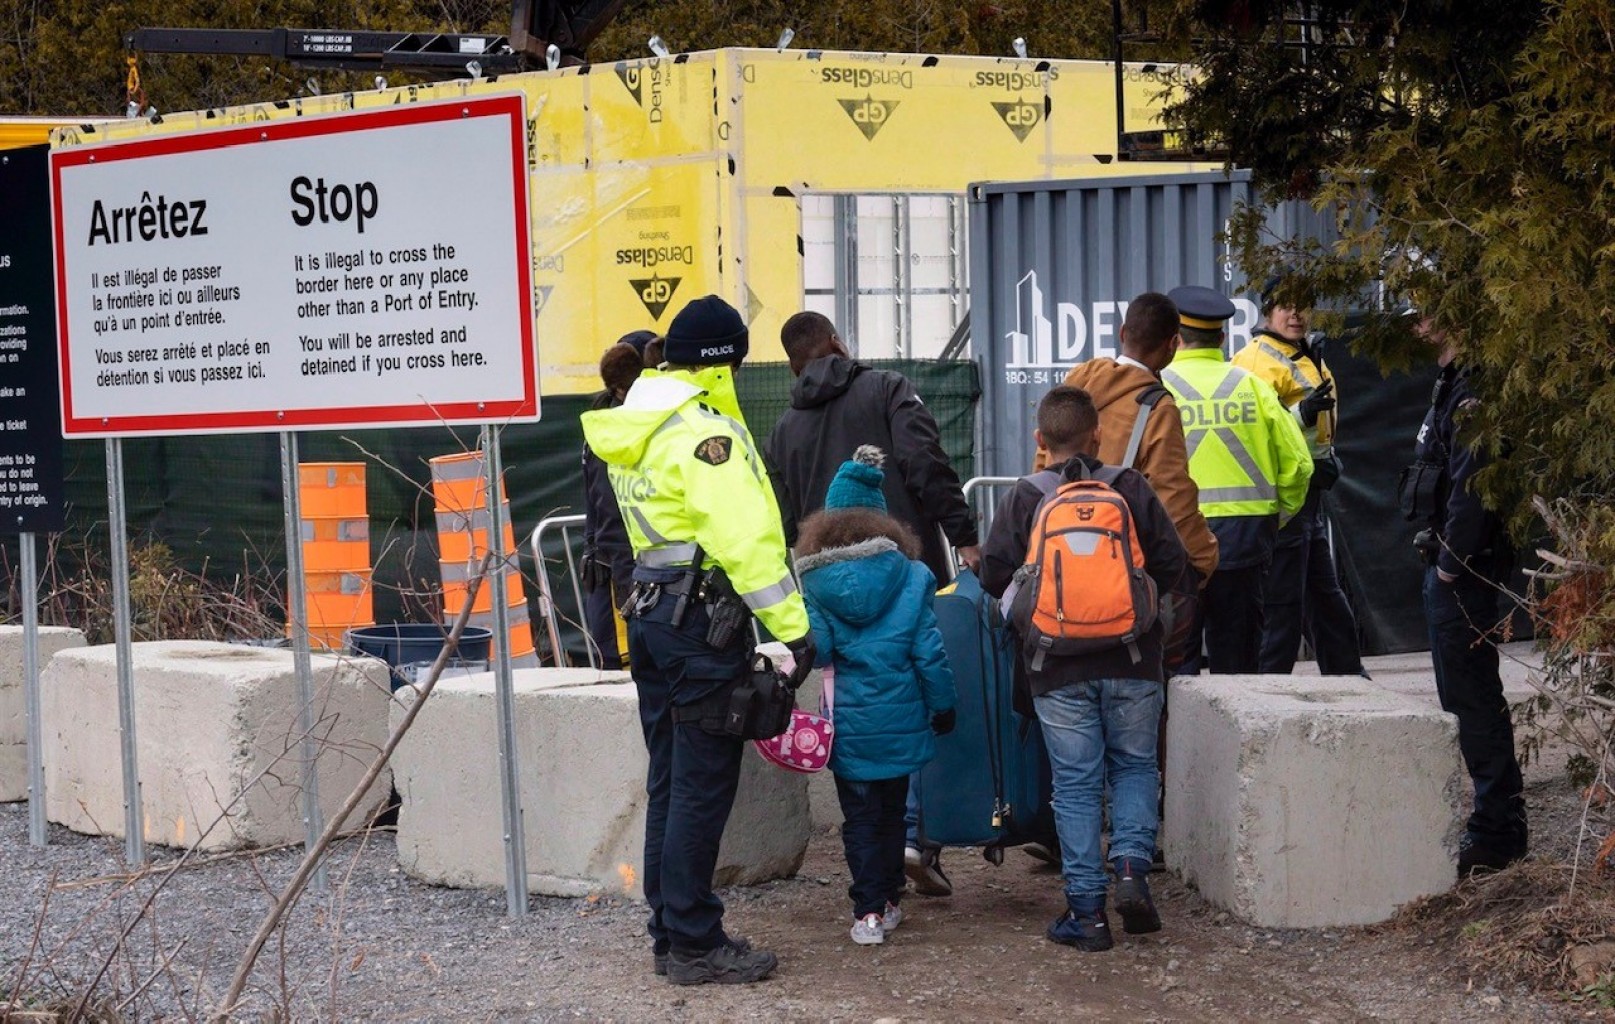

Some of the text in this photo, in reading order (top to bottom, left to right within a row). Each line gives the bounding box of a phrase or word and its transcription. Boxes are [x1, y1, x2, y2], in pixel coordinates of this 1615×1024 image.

[822, 67, 913, 89] DensGlass
[853, 102, 887, 123] GP
[1006, 105, 1038, 126] GP
[290, 176, 378, 234] Stop
[88, 191, 208, 246] Arrêtez
[295, 243, 455, 271] It is illegal to cross the
[616, 246, 693, 268] DensGlass
[92, 266, 221, 288] Il est illégal de passer
[296, 267, 468, 294] border here or any place
[93, 285, 240, 311] la frontière ici ou ailleurs
[642, 280, 671, 304] GP
[298, 290, 478, 318] other than a Port of Entry.
[94, 308, 225, 336] qu'à un point d'entrée.
[299, 326, 466, 351] You will be arrested and
[8, 354, 19, 363] on
[96, 339, 270, 364] Vous serez arrêté et placé en
[700, 344, 735, 358] POLICE
[97, 362, 265, 386] détention si vous passez ici.
[301, 350, 486, 376] detained if you cross here.
[1034, 371, 1049, 384] 54
[15, 387, 25, 397] an
[1179, 401, 1257, 427] OLICE
[6, 420, 27, 431] ticket
[15, 455, 24, 465] to
[25, 454, 36, 464] be
[8, 468, 19, 479] do
[20, 468, 34, 478] not
[9, 482, 18, 492] to
[19, 481, 39, 492] leave
[14, 494, 22, 505] of
[24, 494, 49, 508] origin.
